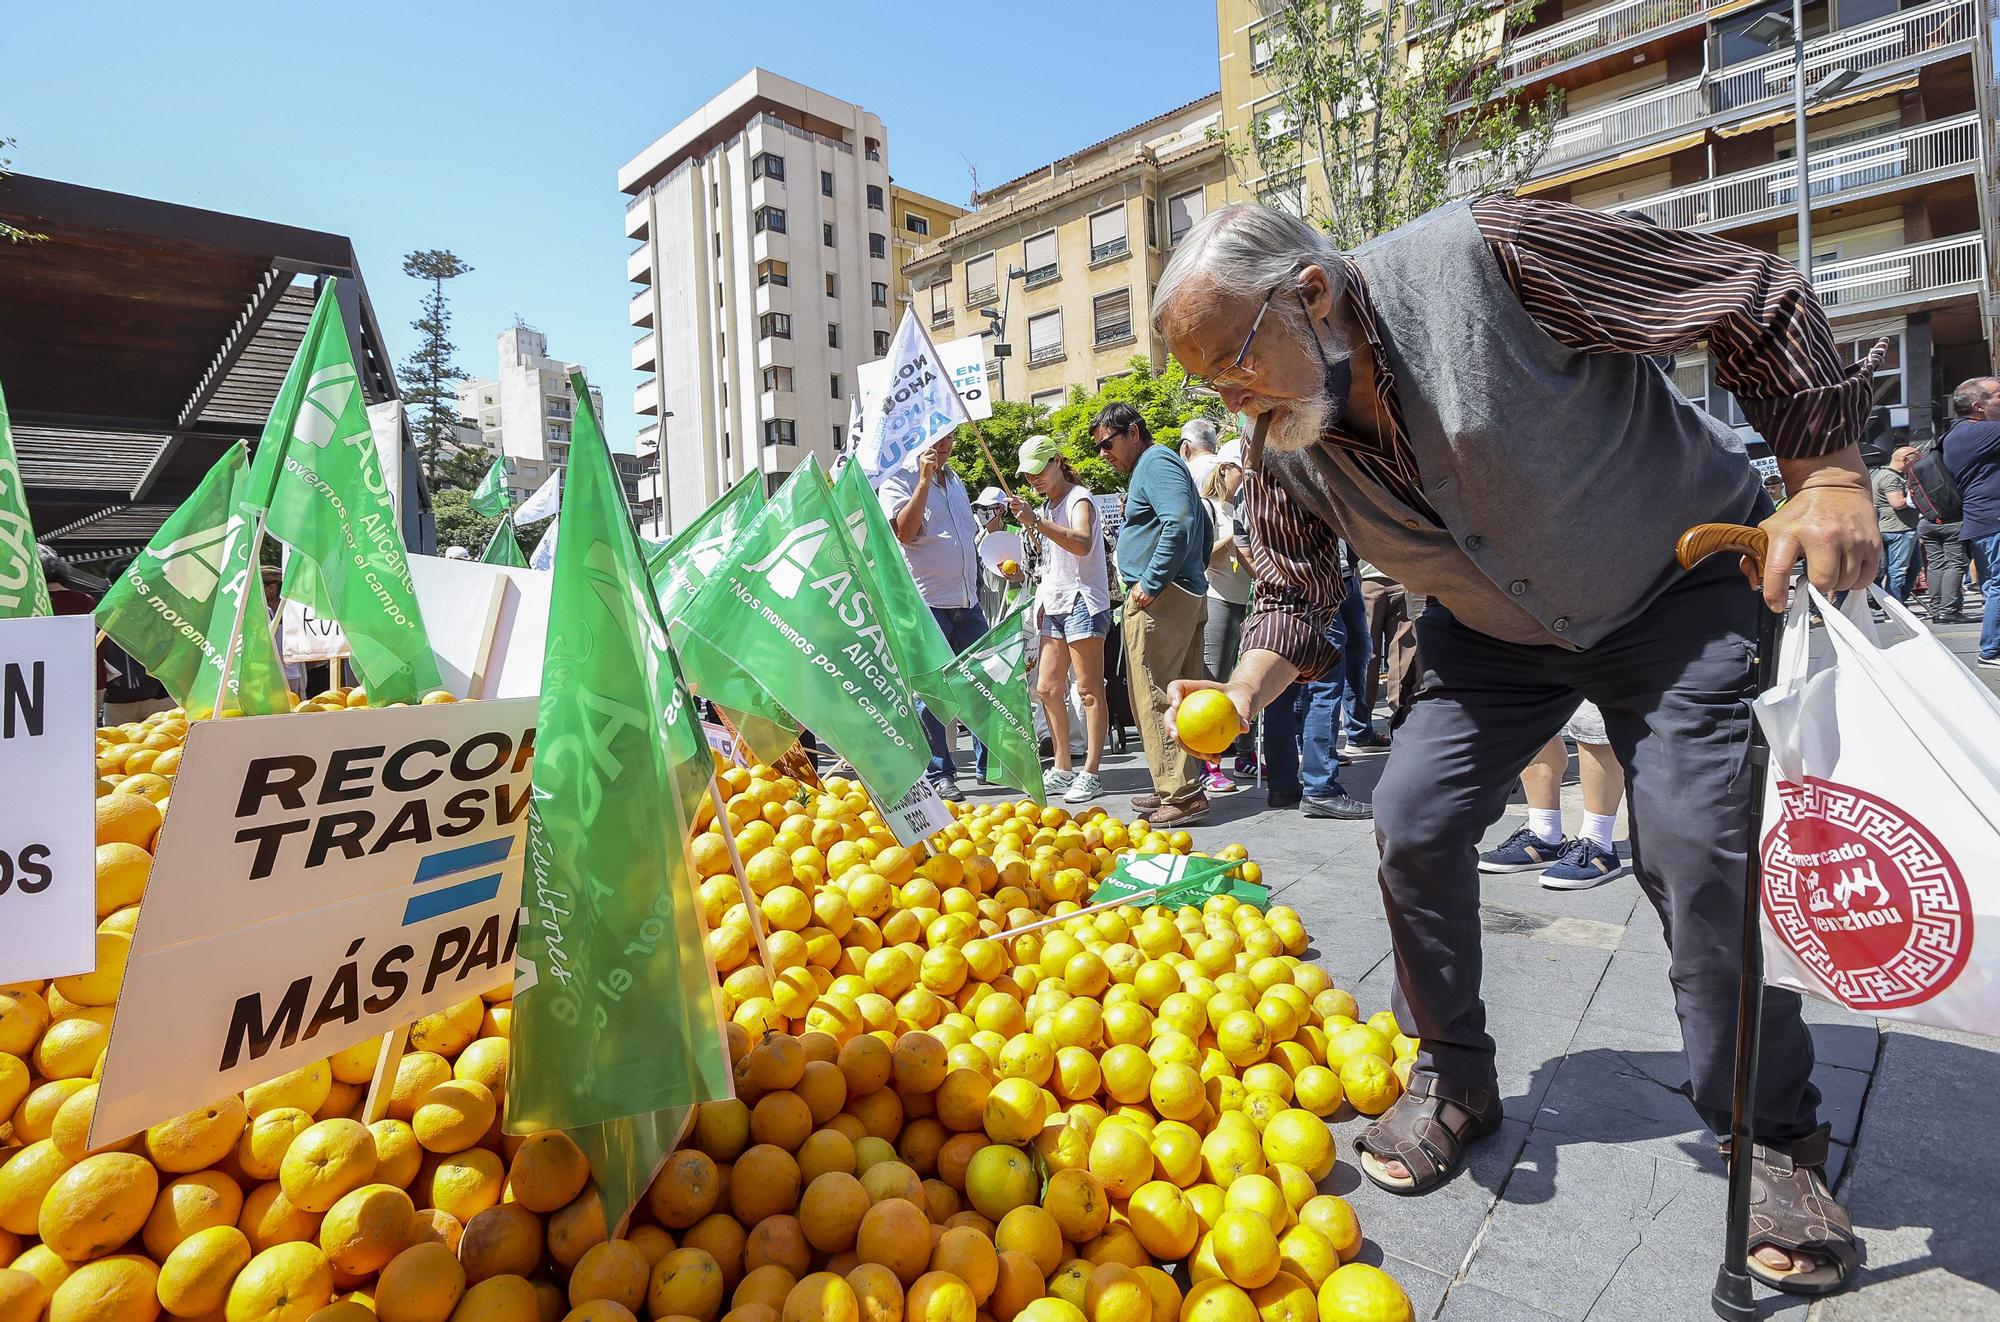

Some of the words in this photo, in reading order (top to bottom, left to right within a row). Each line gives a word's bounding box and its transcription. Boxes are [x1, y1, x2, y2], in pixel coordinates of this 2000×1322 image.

[956, 363, 980, 377] EN
[147, 596, 217, 659] movemos
[729, 576, 761, 610] "Nos
[760, 605, 816, 656] movemos
[810, 652, 845, 678] por
[842, 680, 862, 696] el
[857, 695, 915, 752] campo"
[841, 641, 909, 719] Alicante
[973, 680, 1018, 727] movemos
[1014, 724, 1033, 742] por
[234, 784, 533, 880] TRASV
[218, 937, 415, 1072] MÁS
